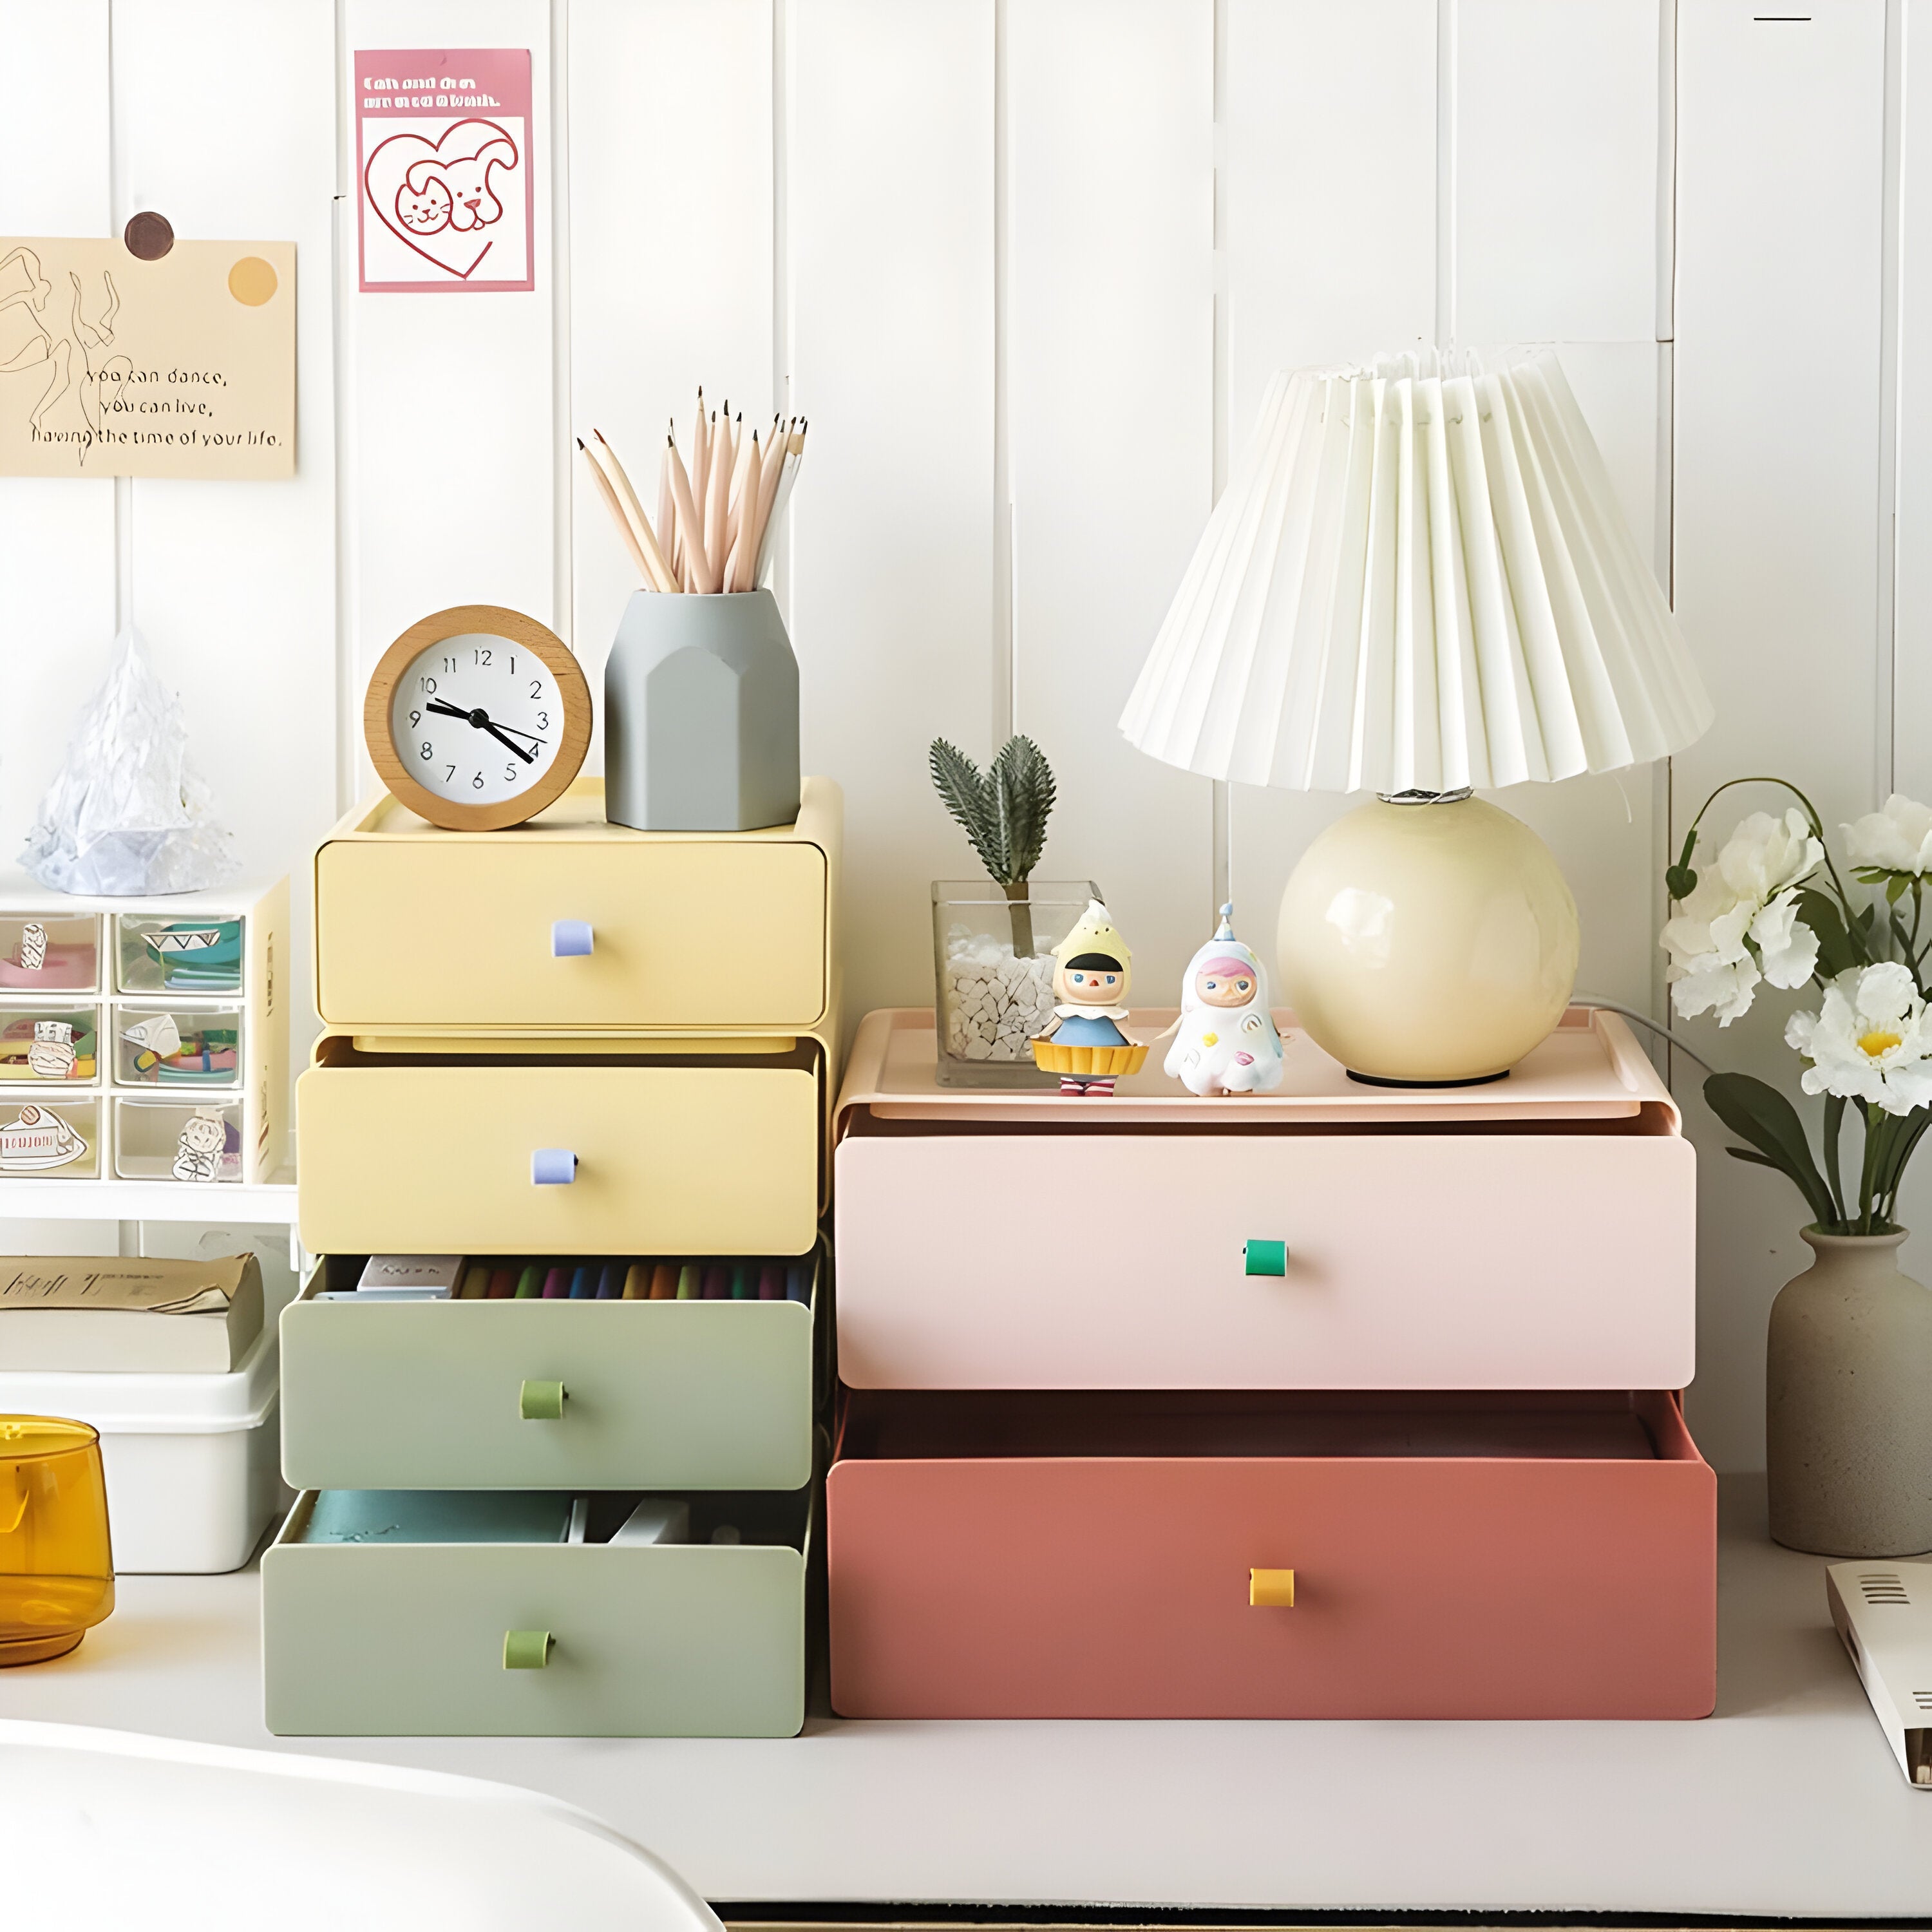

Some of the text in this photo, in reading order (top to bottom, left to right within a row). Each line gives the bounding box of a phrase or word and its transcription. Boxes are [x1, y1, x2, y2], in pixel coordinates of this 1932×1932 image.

[167, 368, 227, 386] dance,
[100, 399, 134, 415] you
[140, 401, 171, 413] can
[180, 429, 196, 445] of
[202, 433, 242, 447] your
[444, 658, 457, 673] 11
[475, 649, 493, 666] 12
[510, 656, 516, 675] 1
[420, 677, 437, 694] 10
[529, 680, 542, 699] 2
[409, 710, 422, 728] 9
[536, 712, 549, 730] 3
[420, 742, 433, 761] 8
[446, 765, 456, 782] 7
[472, 772, 484, 790] 6
[504, 763, 517, 781] 5
